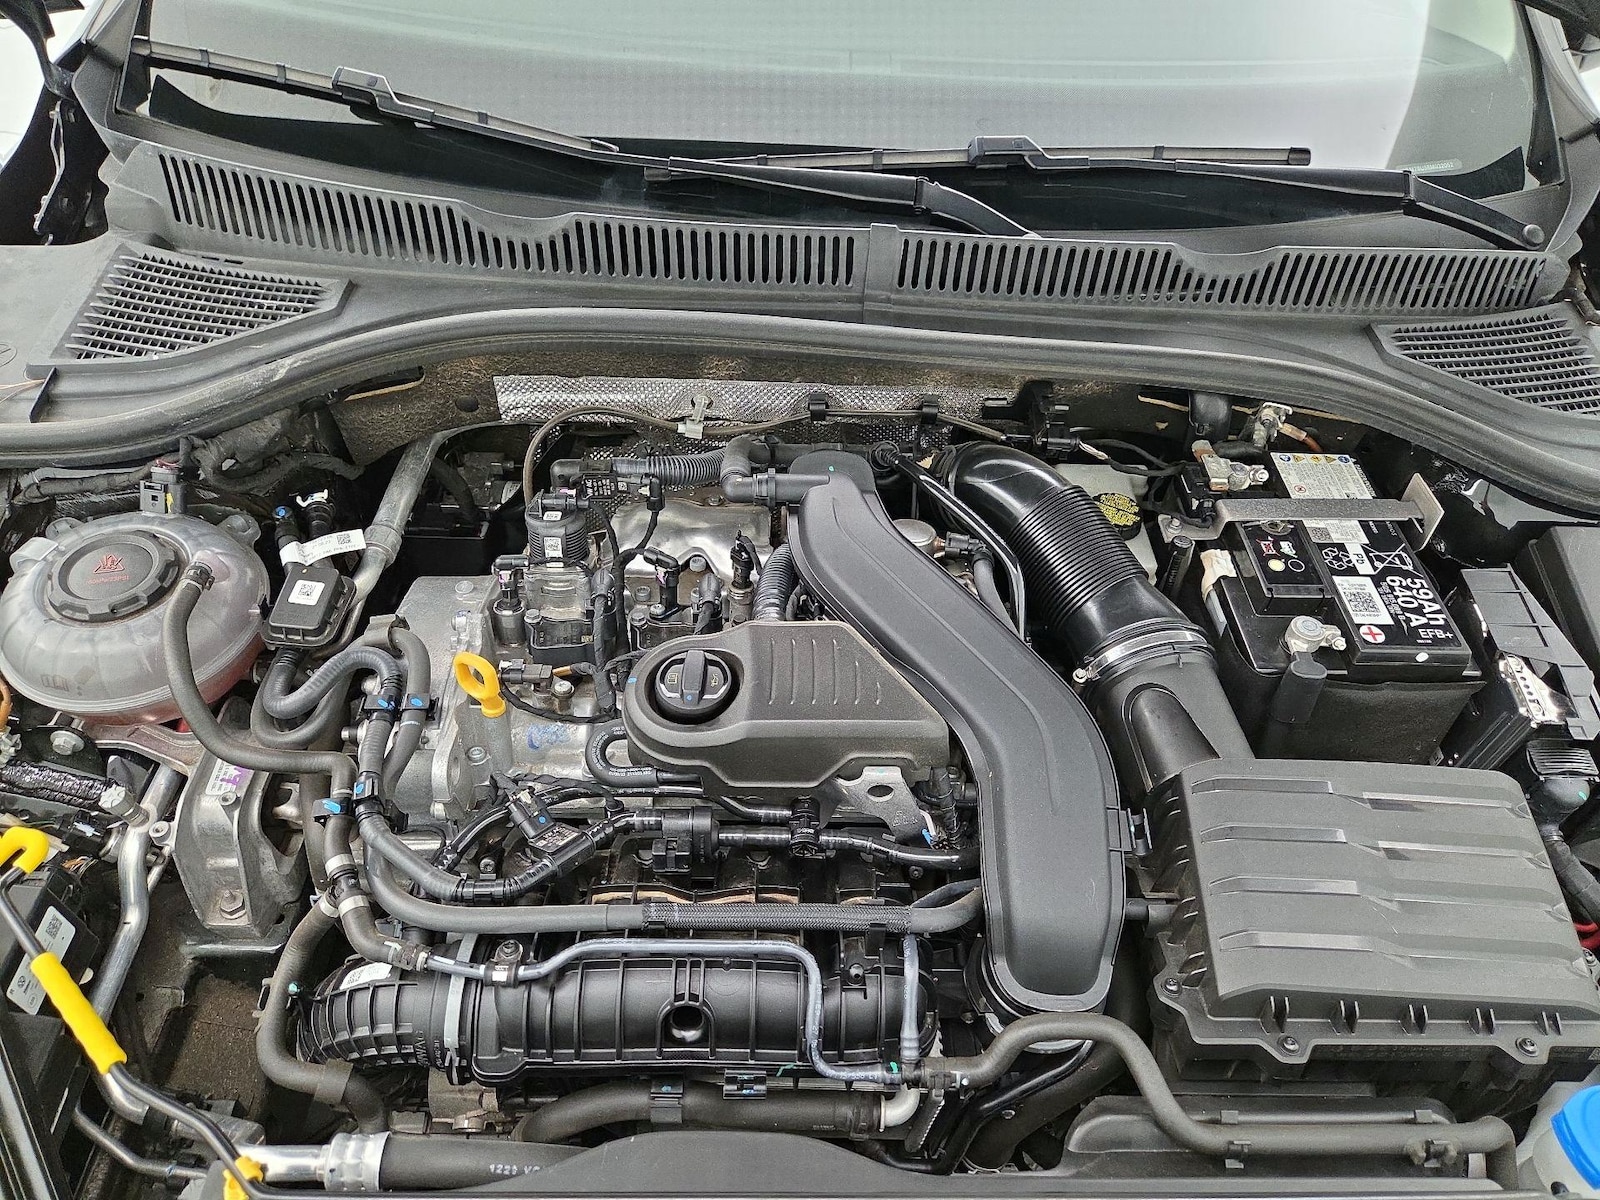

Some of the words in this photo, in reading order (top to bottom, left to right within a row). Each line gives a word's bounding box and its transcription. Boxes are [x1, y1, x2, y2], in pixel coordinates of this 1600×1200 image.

[1353, 553, 1365, 564] Pb
[1386, 576, 1418, 608] 640
[1404, 612, 1428, 627] A
[1406, 578, 1447, 625] 59Ah
[1418, 628, 1454, 639] EFB+
